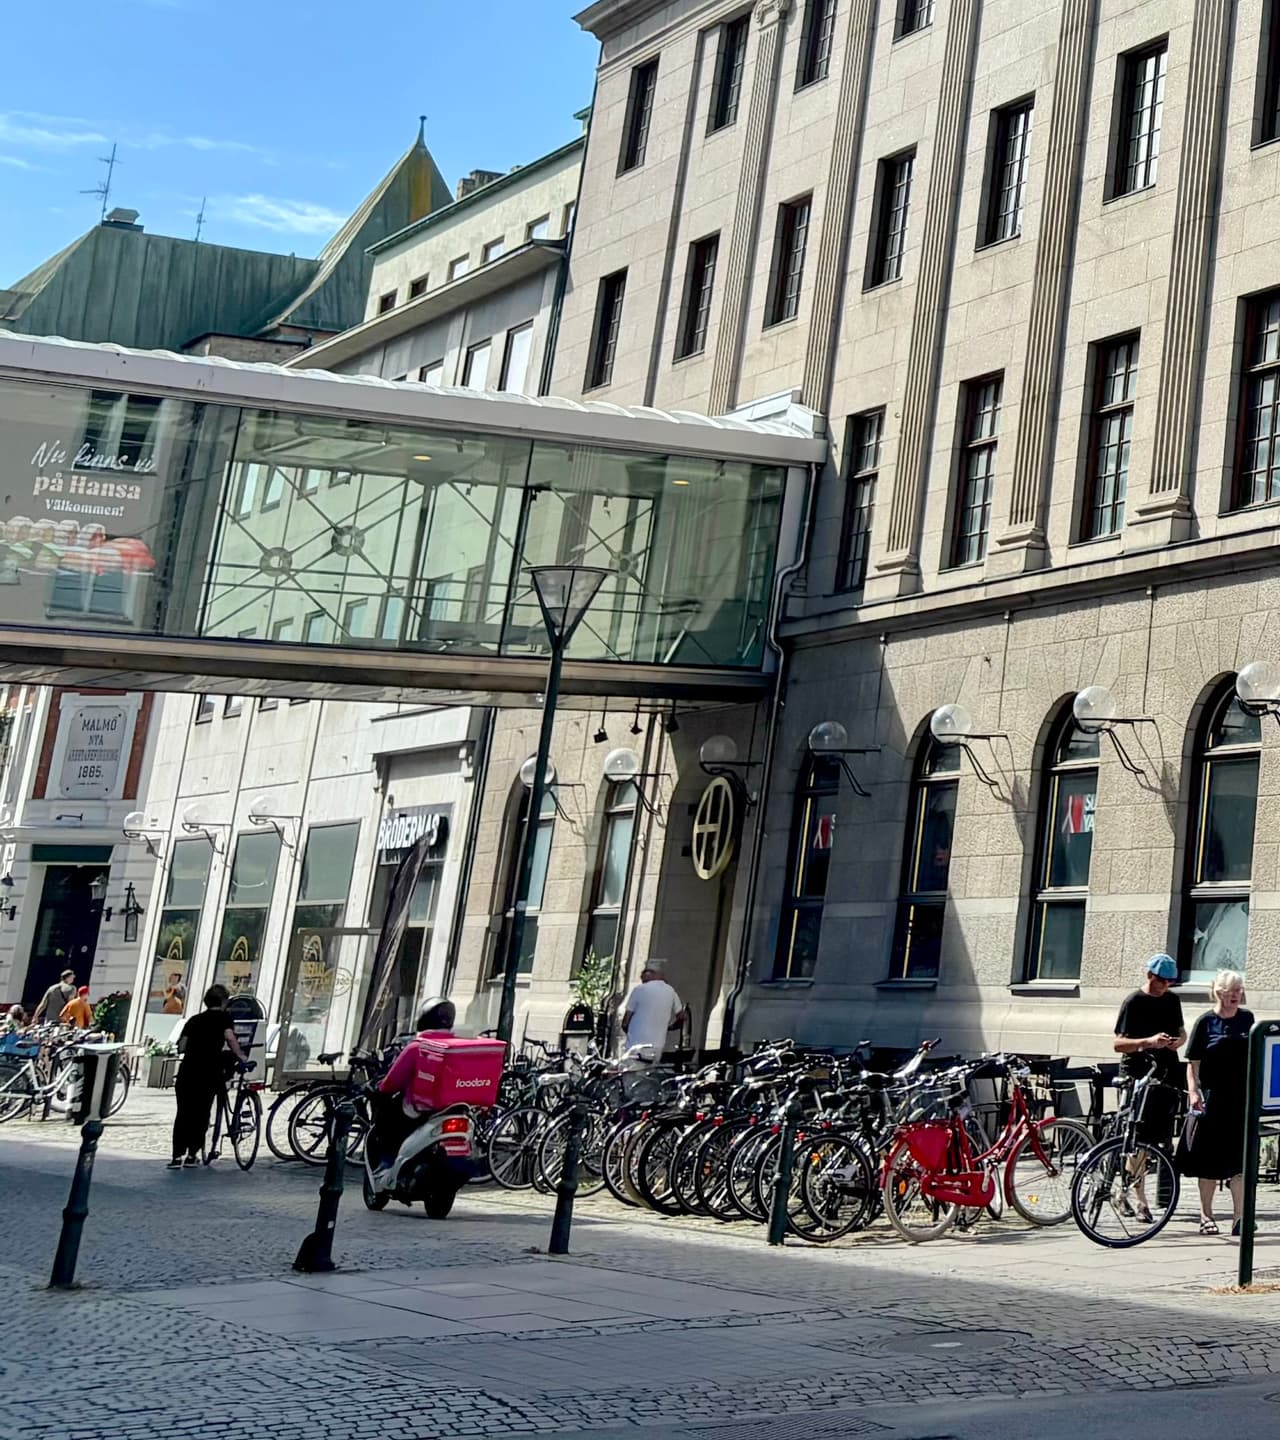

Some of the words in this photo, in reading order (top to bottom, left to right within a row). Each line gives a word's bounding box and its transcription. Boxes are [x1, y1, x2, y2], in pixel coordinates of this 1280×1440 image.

[33, 472, 63, 495] på
[69, 475, 141, 499] Hansa
[45, 498, 124, 517] Välkommen!
[81, 716, 117, 731] MALMÖ
[455, 1078, 491, 1088] foodora
